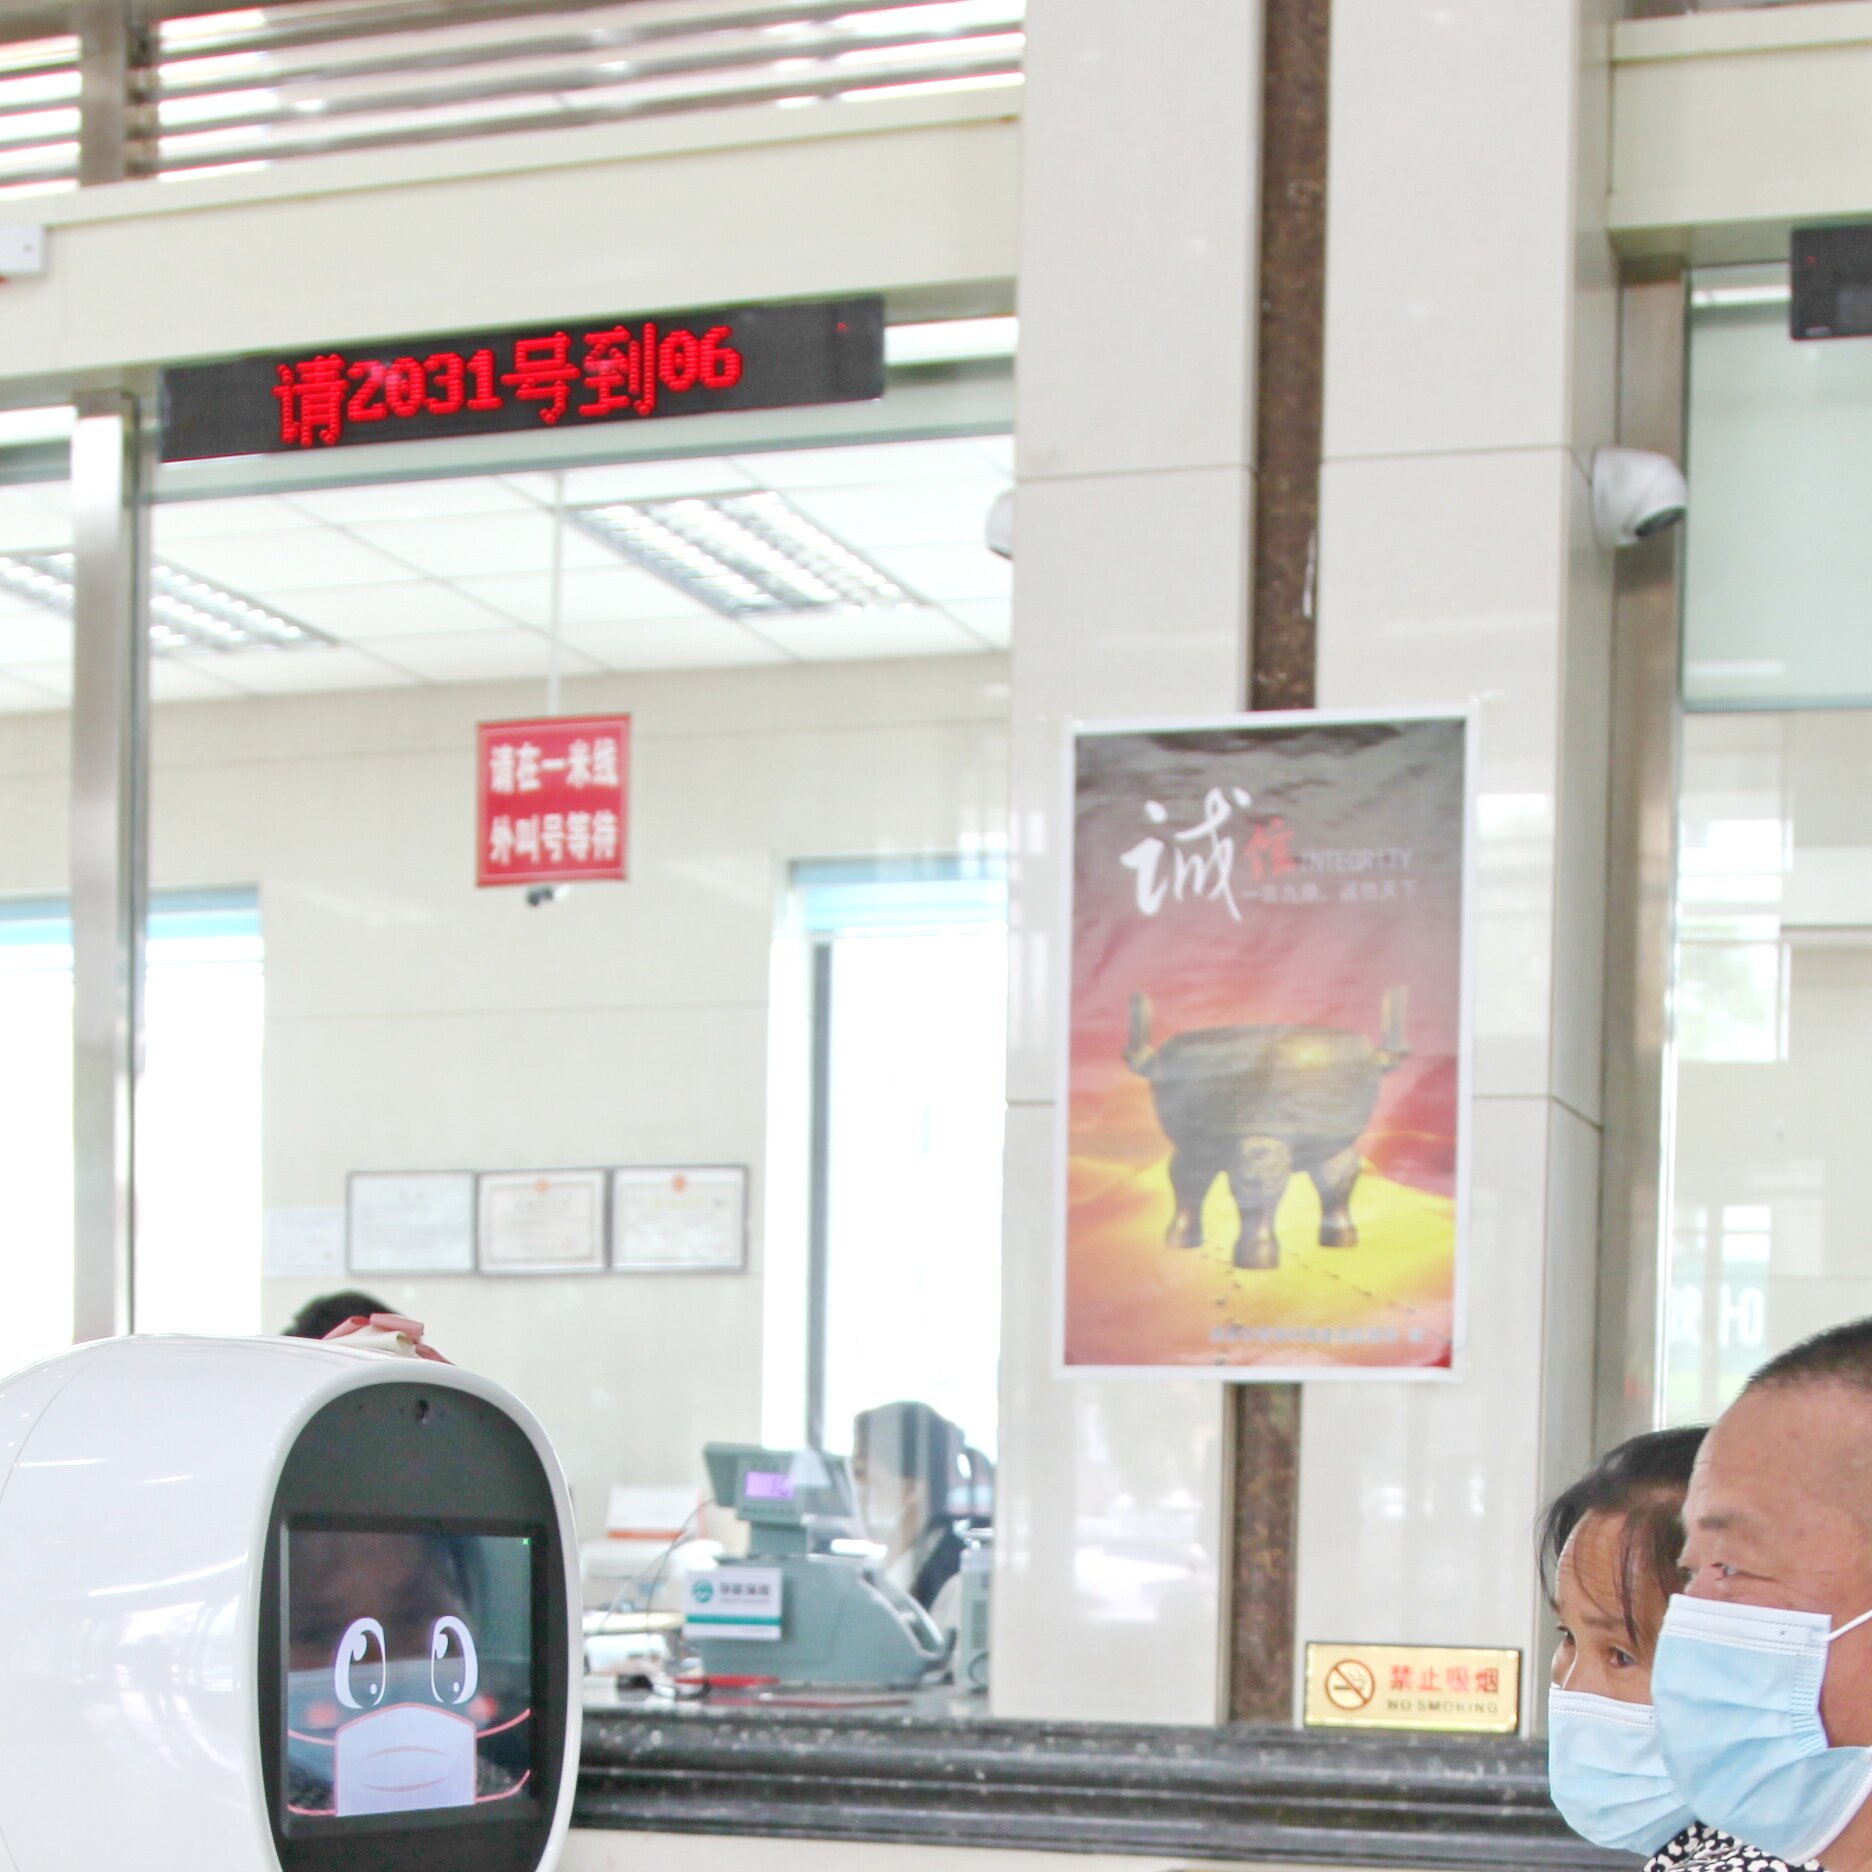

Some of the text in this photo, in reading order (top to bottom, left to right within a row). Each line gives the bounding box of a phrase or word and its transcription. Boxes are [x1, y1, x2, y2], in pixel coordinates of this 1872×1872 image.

[272, 321, 743, 447] 请2031号到06
[489, 737, 619, 795] 请在一米线
[489, 808, 617, 866] 外叫号等待
[1388, 1700, 1499, 1714] NO SMOKING
[1389, 1664, 1499, 1693] 禁止吸烟
